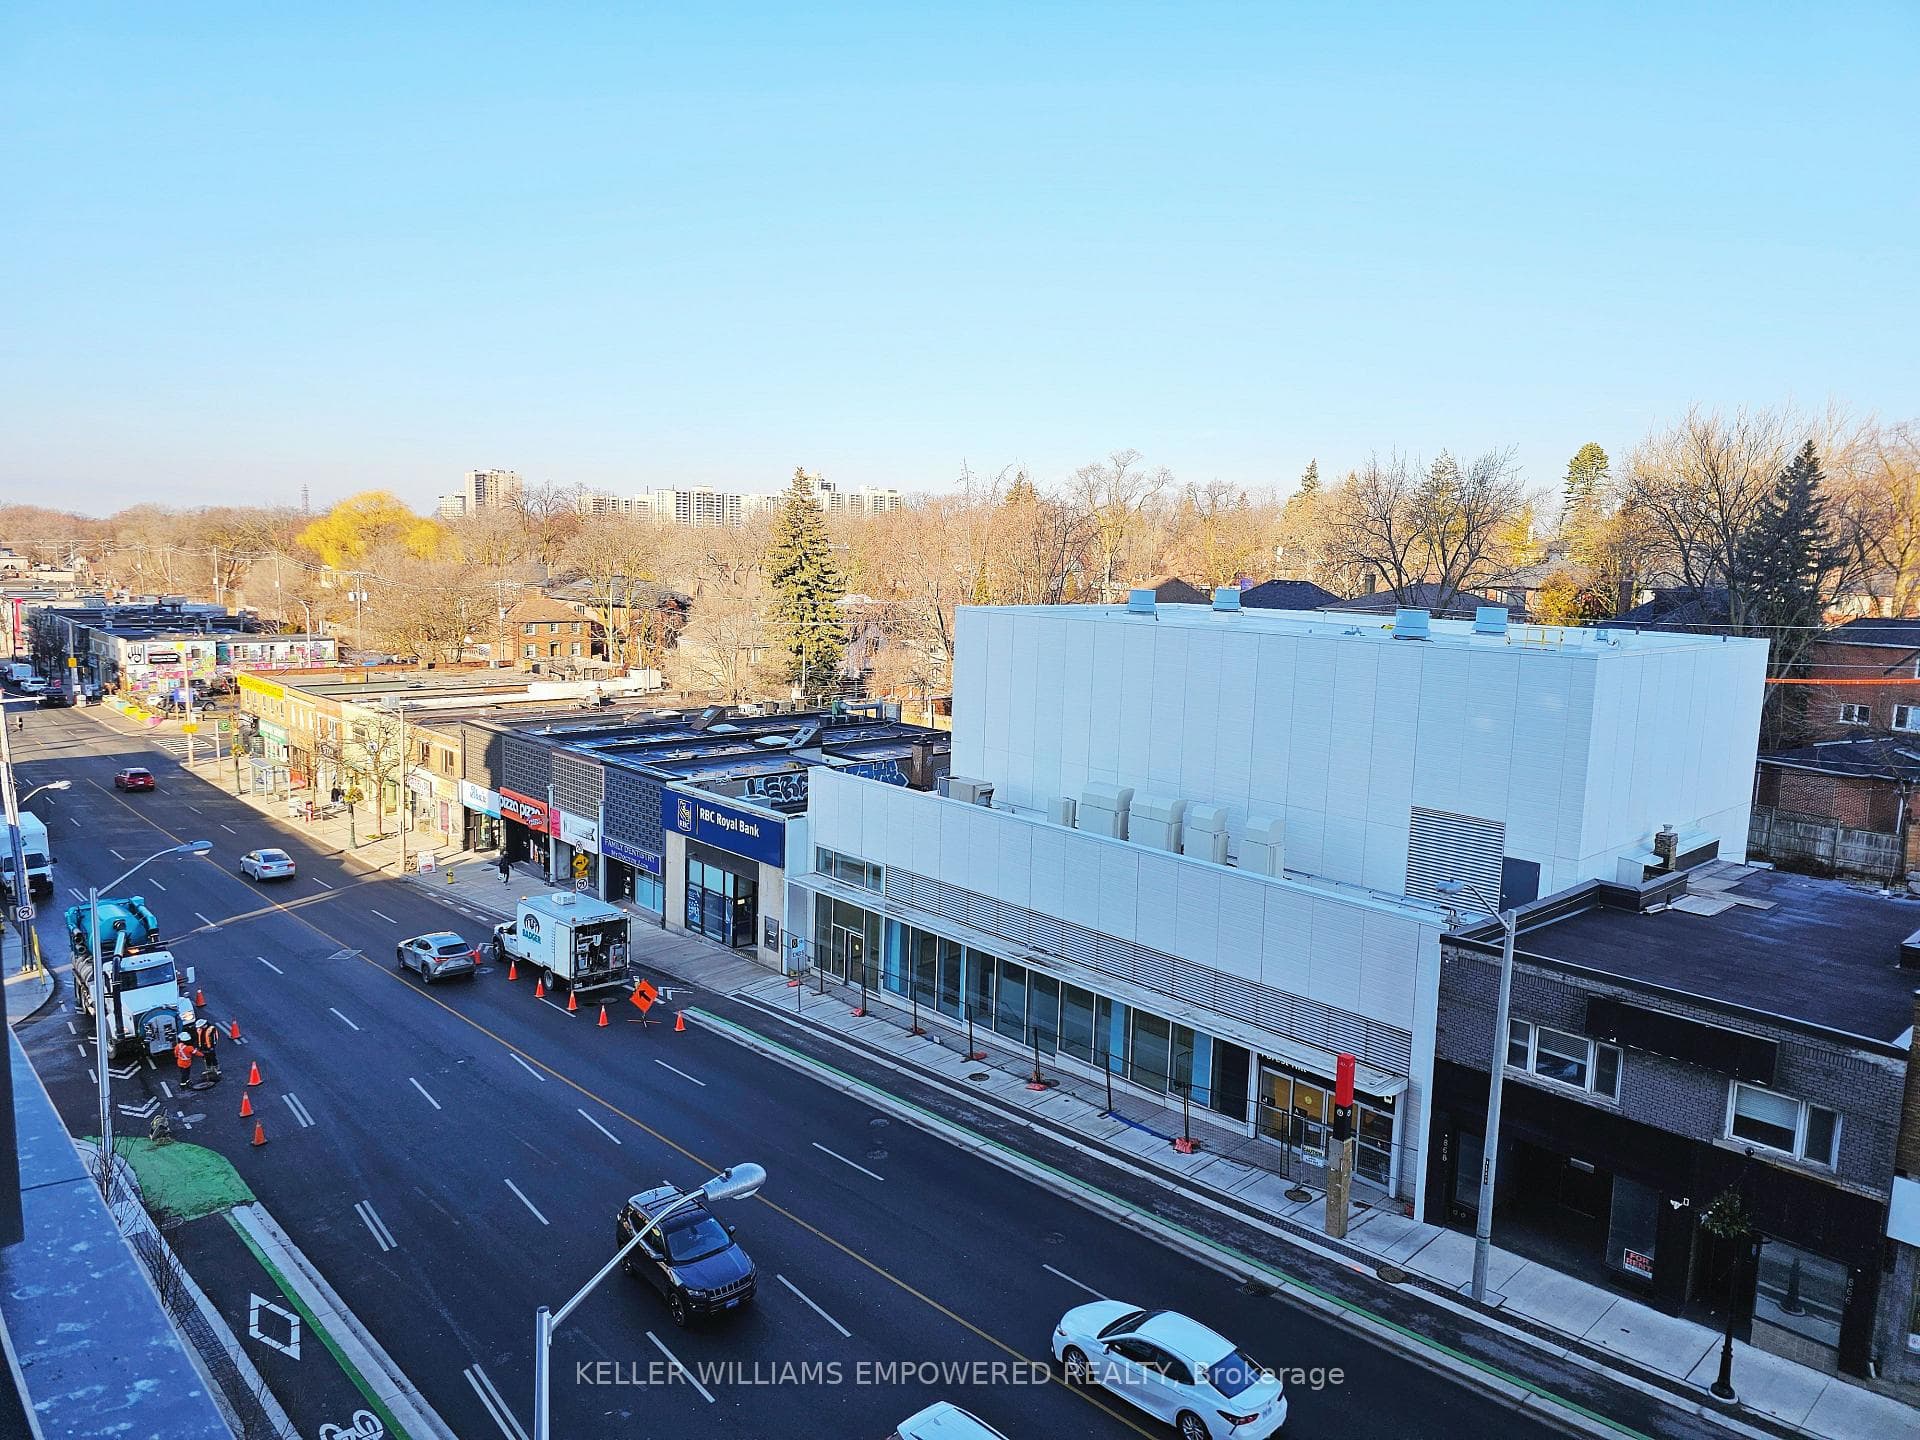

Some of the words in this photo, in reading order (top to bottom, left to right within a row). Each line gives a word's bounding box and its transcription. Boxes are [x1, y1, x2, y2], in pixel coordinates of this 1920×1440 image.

[680, 820, 690, 829] RBC
[700, 807, 715, 823] RBC
[716, 812, 738, 831] Royal
[739, 821, 760, 838] Bank
[605, 839, 624, 851] FAMILY
[624, 846, 656, 863] DENTISTRY
[1626, 1257, 1654, 1271] RENT
[1629, 1252, 1649, 1265] FOR
